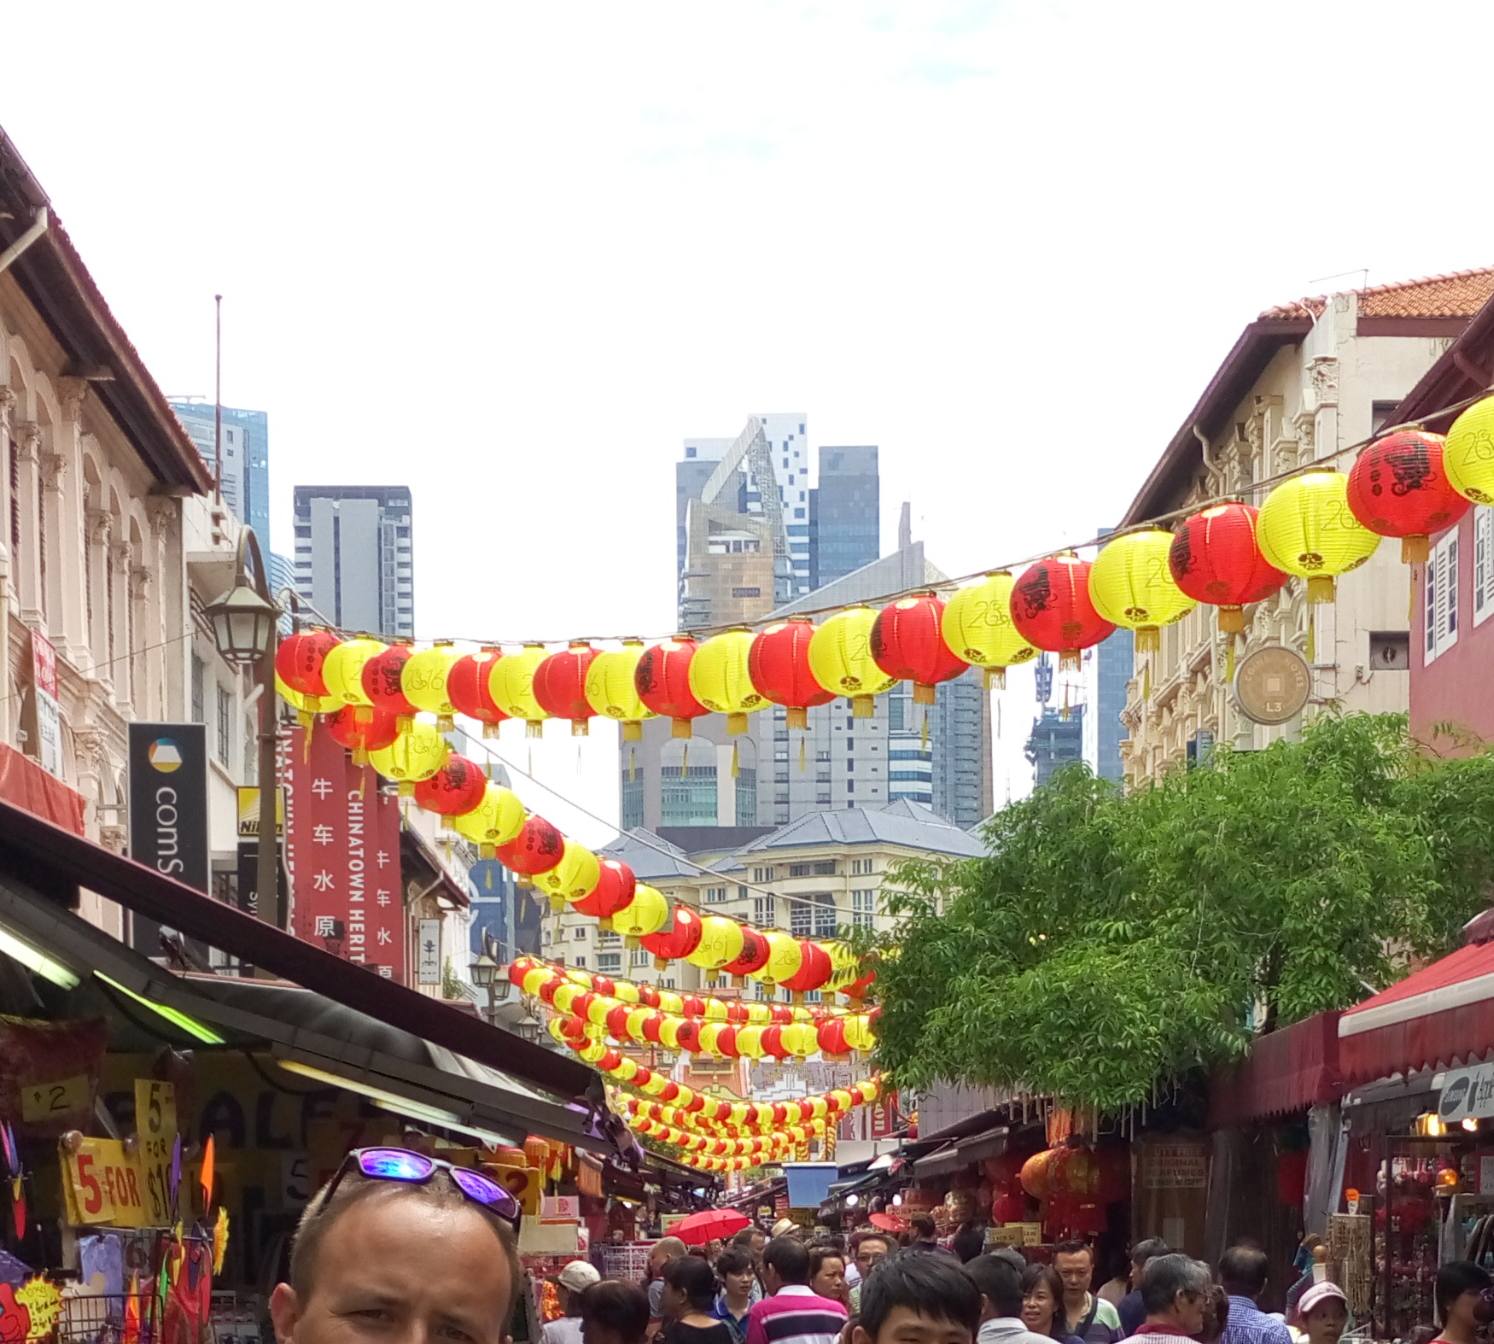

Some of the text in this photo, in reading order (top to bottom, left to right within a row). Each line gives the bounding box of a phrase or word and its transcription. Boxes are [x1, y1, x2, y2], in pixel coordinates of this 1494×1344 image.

[312, 778, 336, 938] 牛车水原
[348, 790, 365, 902] CHINATOWN
[149, 1083, 162, 1134] 5
[146, 1139, 167, 1157] FOR
[77, 1154, 102, 1215] 5
